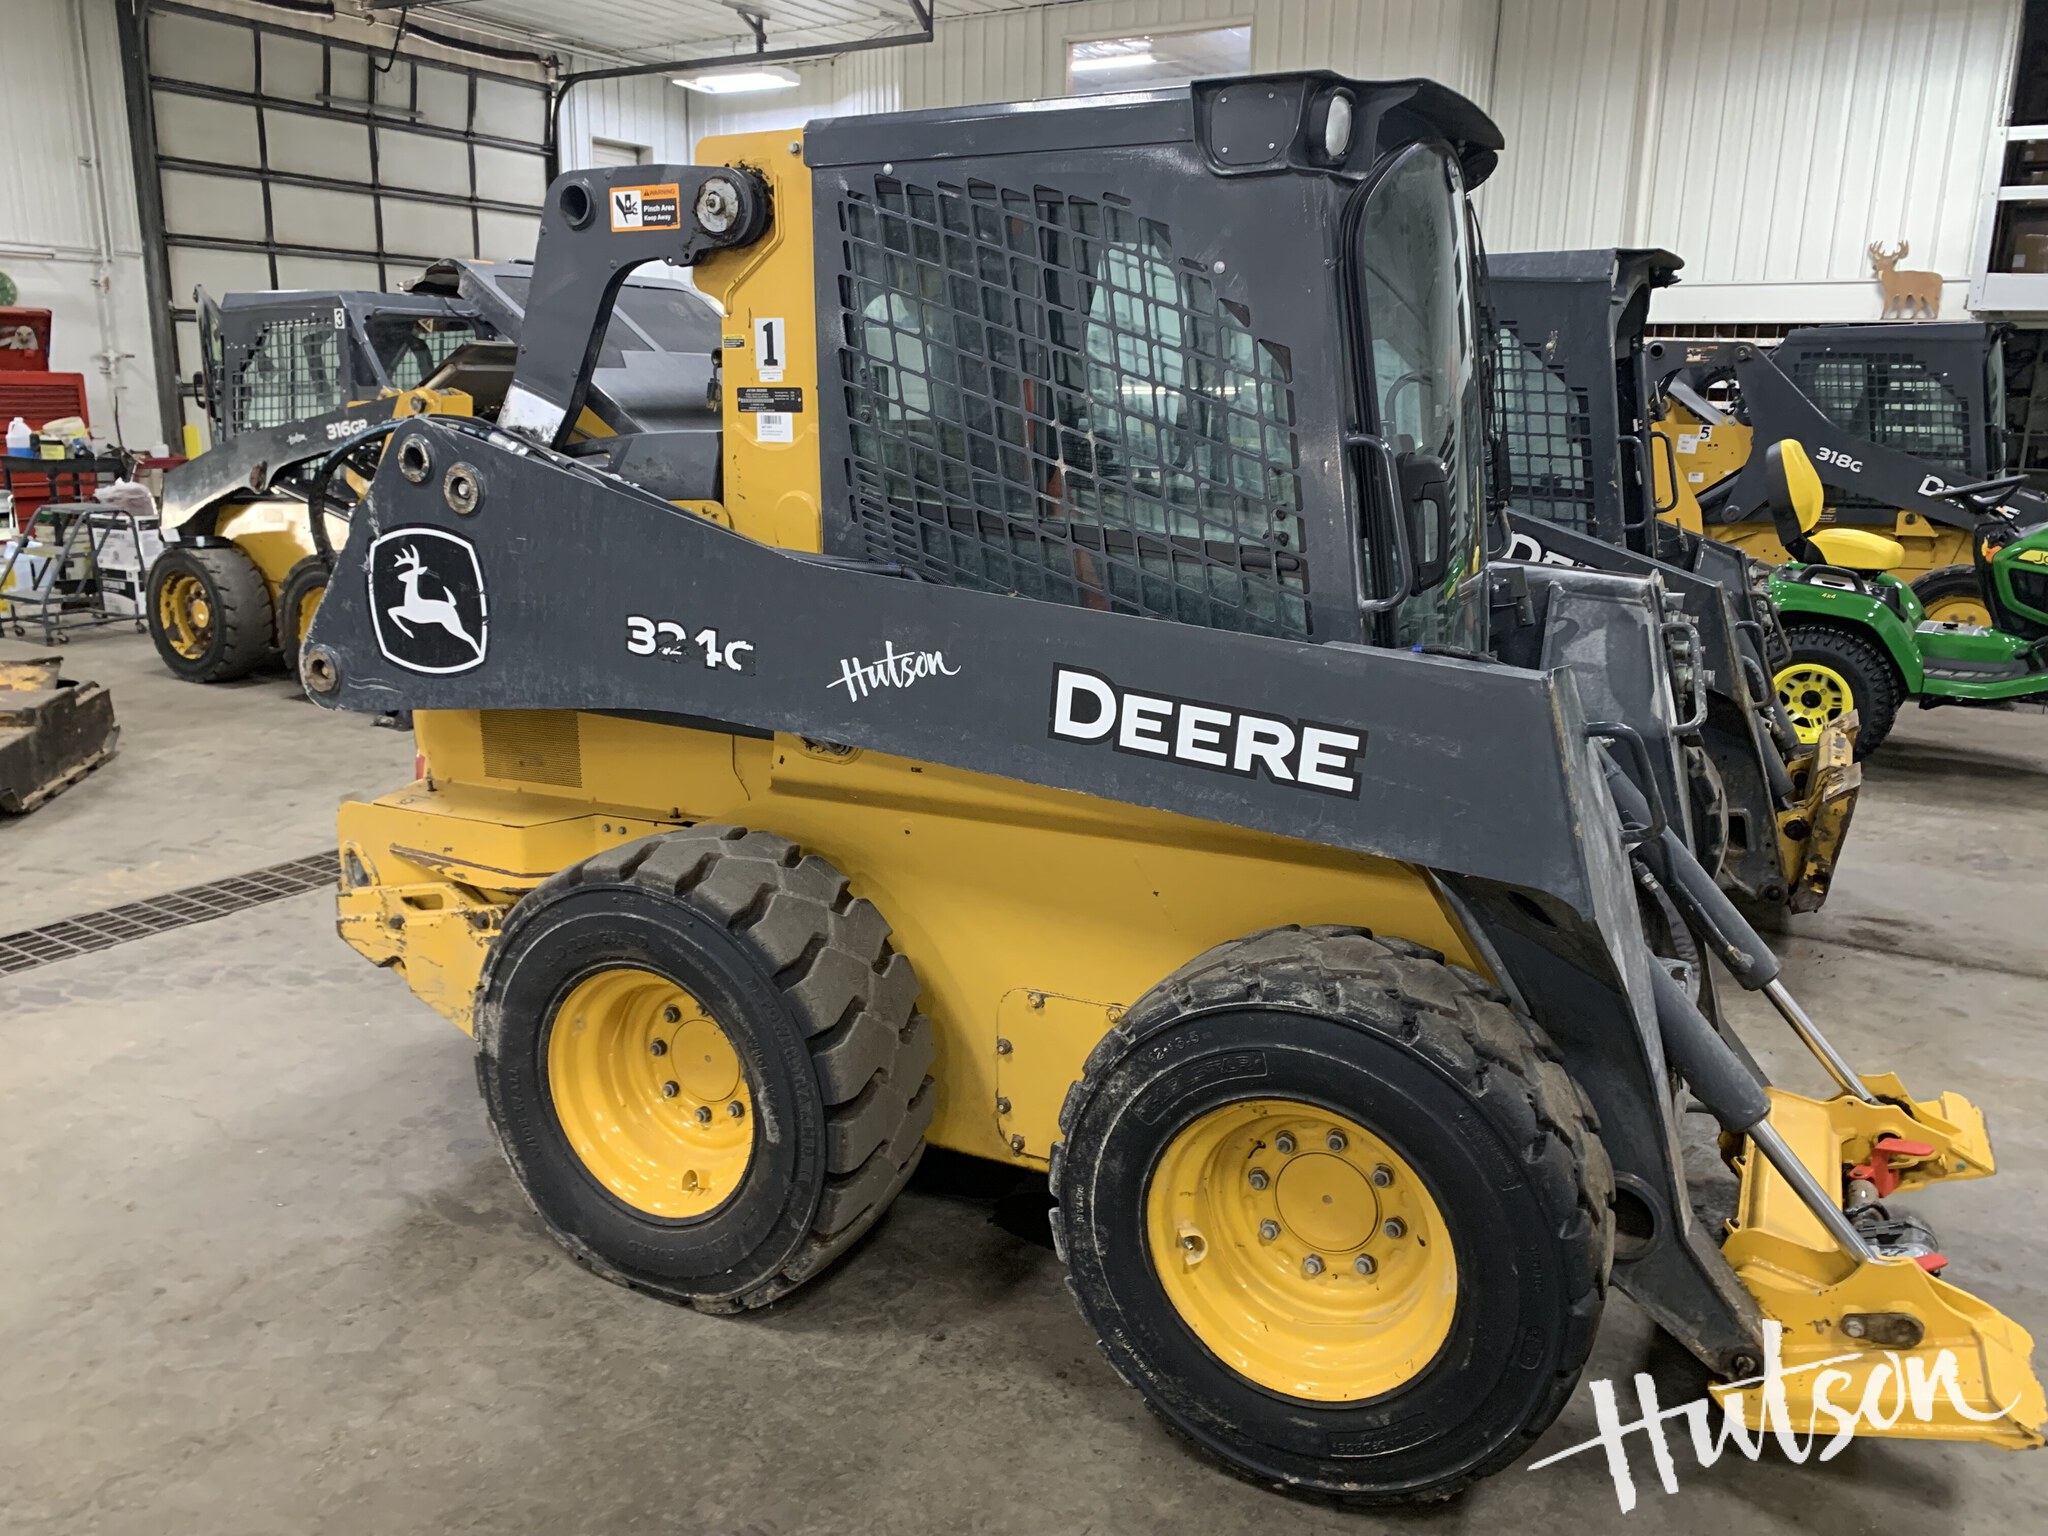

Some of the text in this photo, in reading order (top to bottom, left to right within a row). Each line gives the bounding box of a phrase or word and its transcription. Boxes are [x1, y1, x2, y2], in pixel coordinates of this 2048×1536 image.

[335, 310, 343, 327] 3
[763, 322, 778, 366] 1
[1700, 427, 1710, 440] 5
[1815, 446, 1863, 473] 318G
[826, 640, 962, 703] Hutson
[1054, 669, 1360, 792] DEERE
